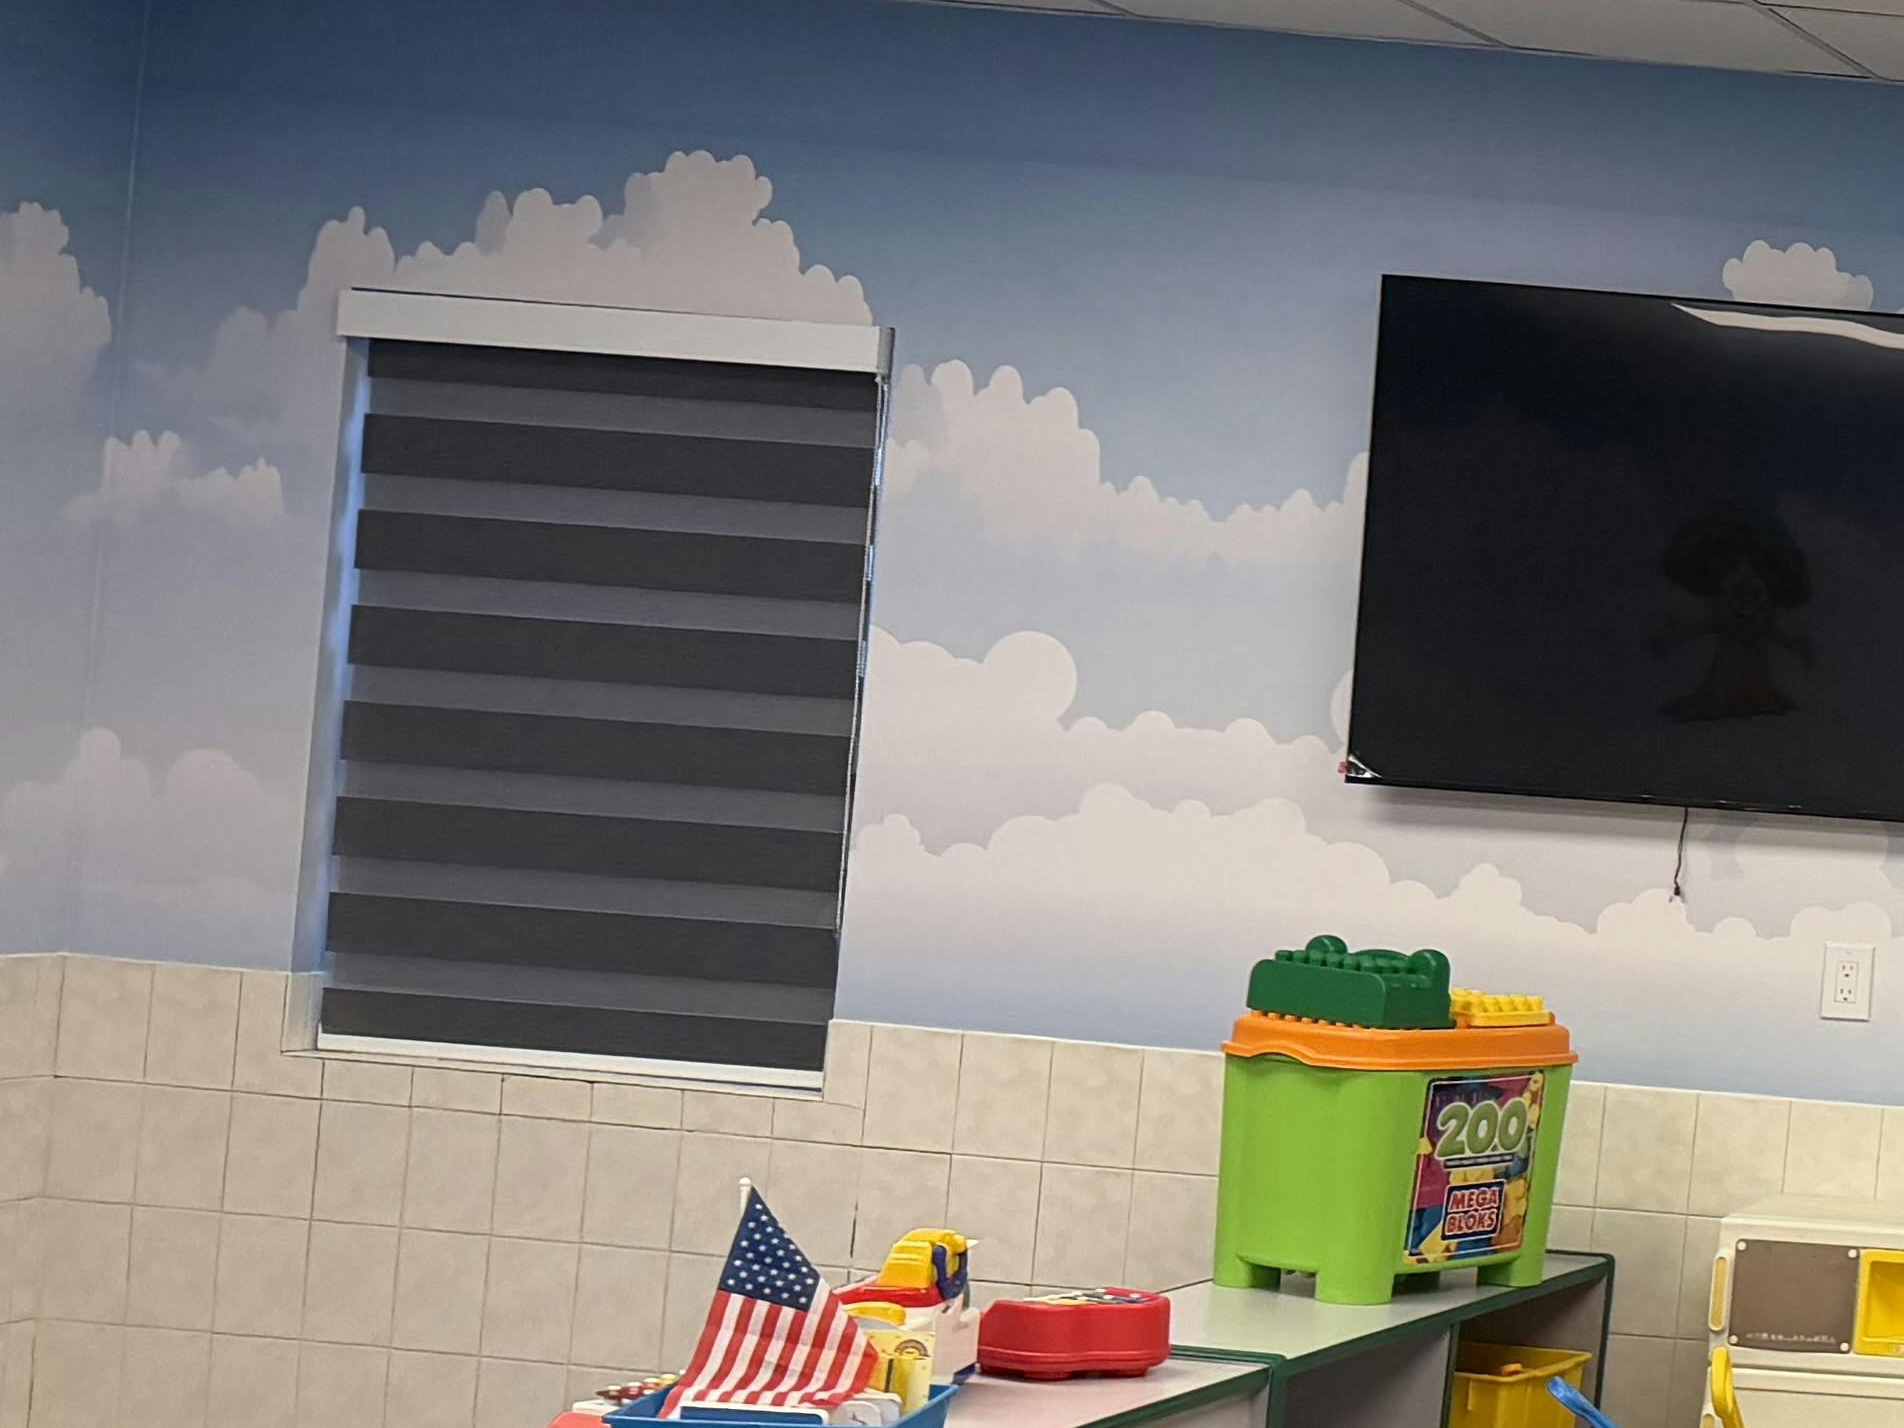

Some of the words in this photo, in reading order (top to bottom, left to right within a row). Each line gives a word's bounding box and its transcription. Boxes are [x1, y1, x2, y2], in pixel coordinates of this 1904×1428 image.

[1435, 1098, 1527, 1159] 200
[1450, 1188, 1498, 1211] MEGA
[1446, 1210, 1497, 1234] BLOKS
